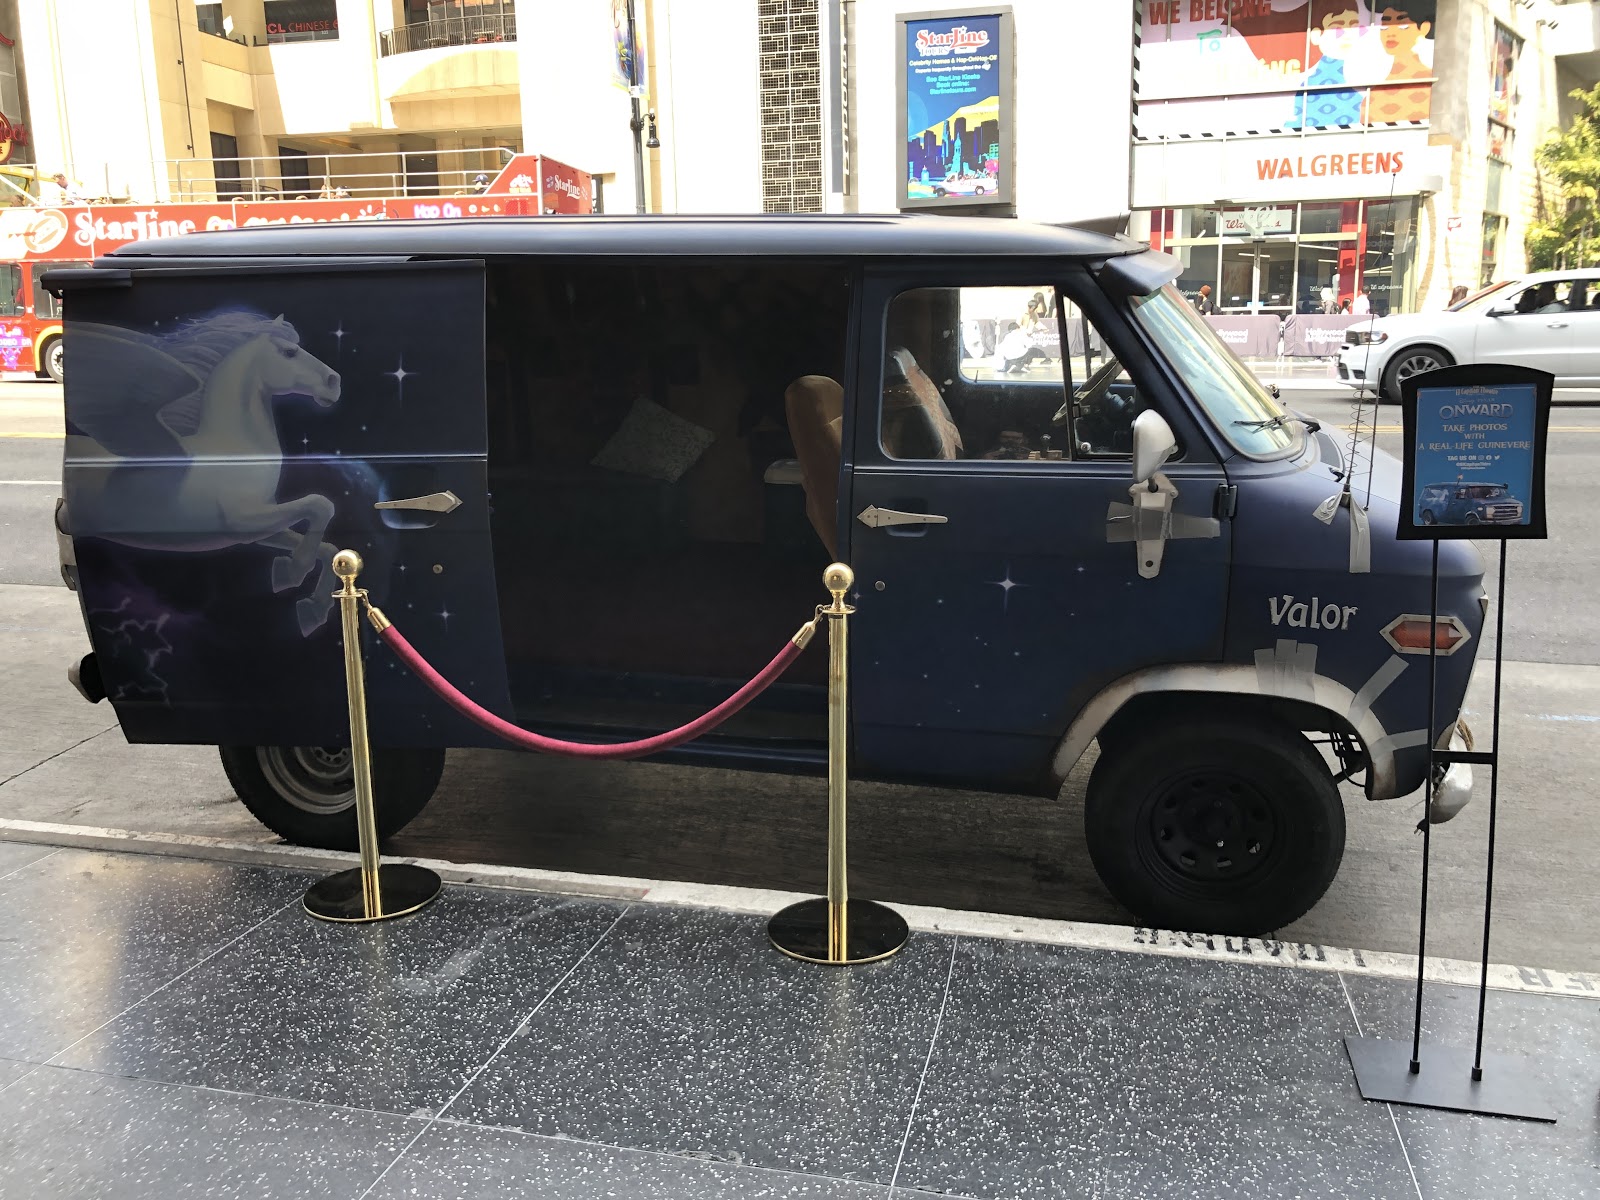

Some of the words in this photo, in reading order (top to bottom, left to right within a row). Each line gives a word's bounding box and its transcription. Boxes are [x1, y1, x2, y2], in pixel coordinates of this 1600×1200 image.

[1149, 1, 1181, 25] WE
[1190, 0, 1270, 22] BELONG
[266, 23, 286, 34] CL
[288, 20, 330, 32] CHINESE
[915, 26, 990, 49] StarLine
[1257, 151, 1404, 181] WALGREENS
[74, 209, 197, 246] StarLine
[1305, 328, 1347, 336] Hollywood
[1439, 403, 1514, 420] ONWARD
[1442, 424, 1466, 434] TAKE
[1470, 423, 1508, 431] PHOTOS
[1429, 442, 1474, 452] REAL-LIFE
[1477, 440, 1532, 450] GUINEVERE
[1268, 594, 1358, 630] Valor
